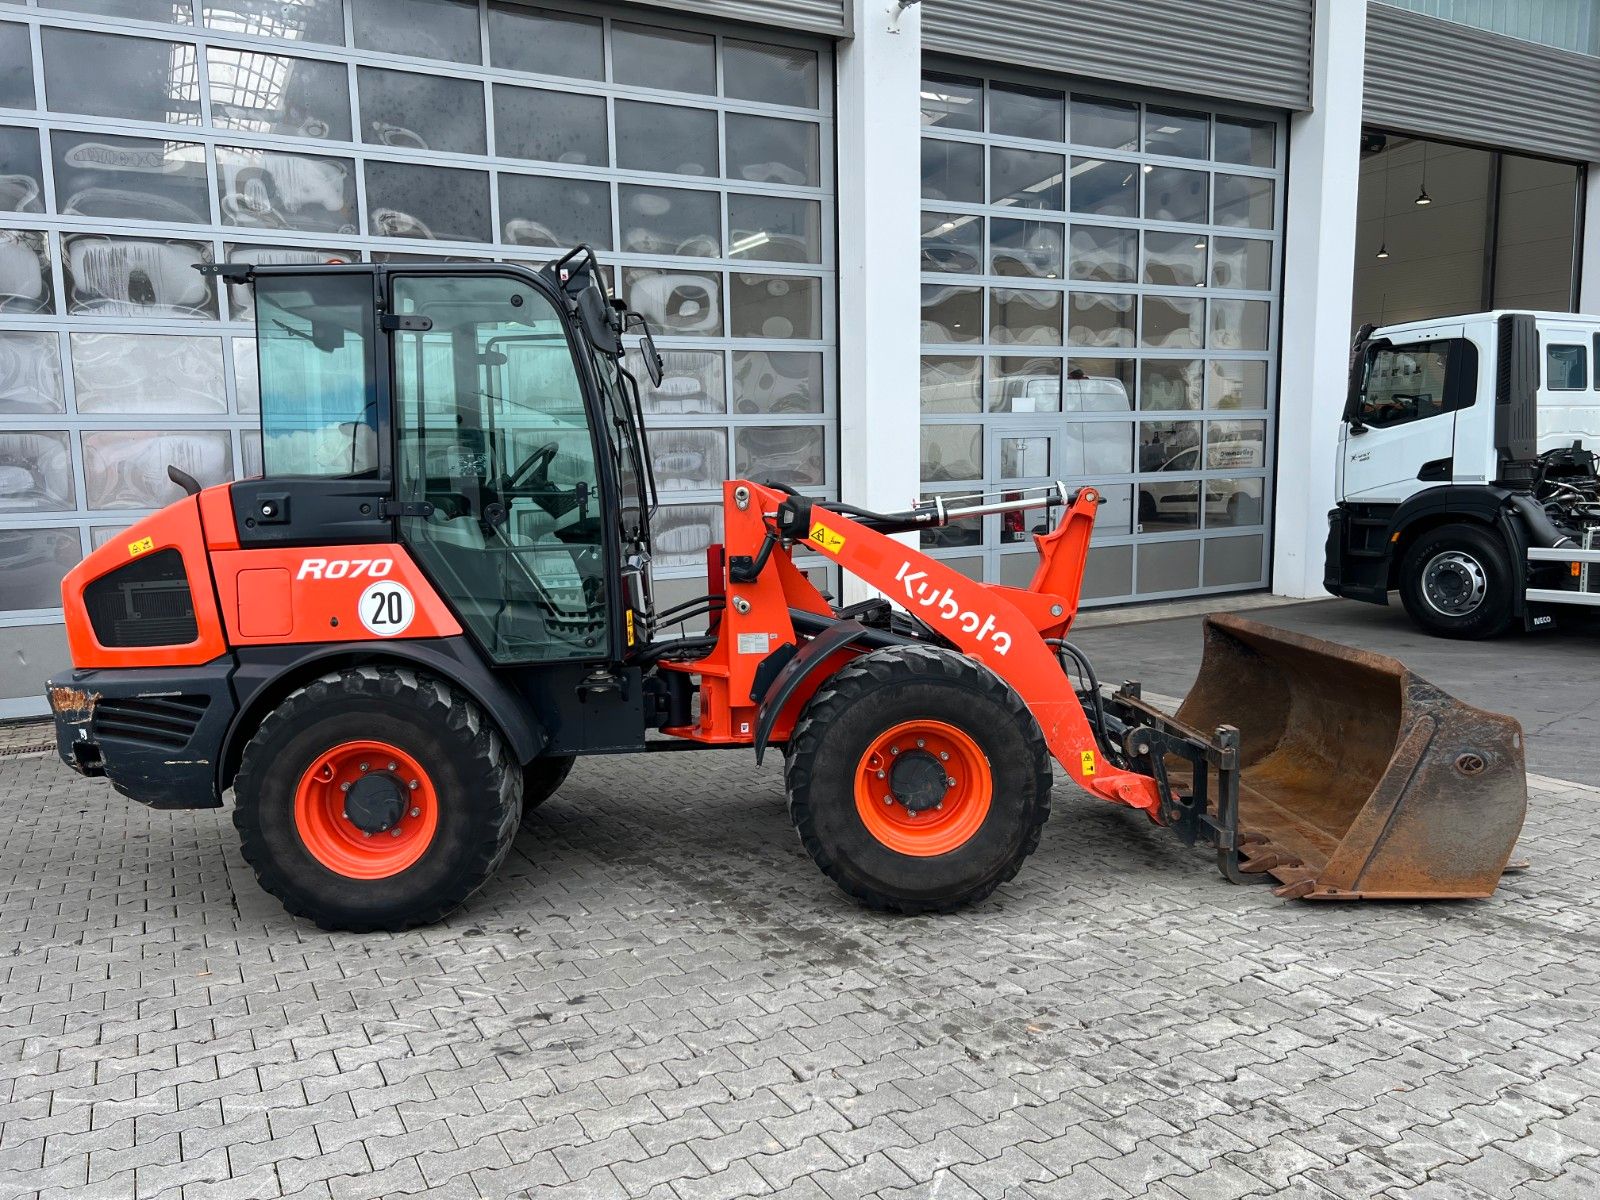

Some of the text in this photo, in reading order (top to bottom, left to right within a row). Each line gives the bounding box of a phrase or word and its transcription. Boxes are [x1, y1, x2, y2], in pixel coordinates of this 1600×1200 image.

[296, 558, 393, 580] R070
[371, 591, 403, 625] 20
[895, 560, 1012, 656] Kubota
